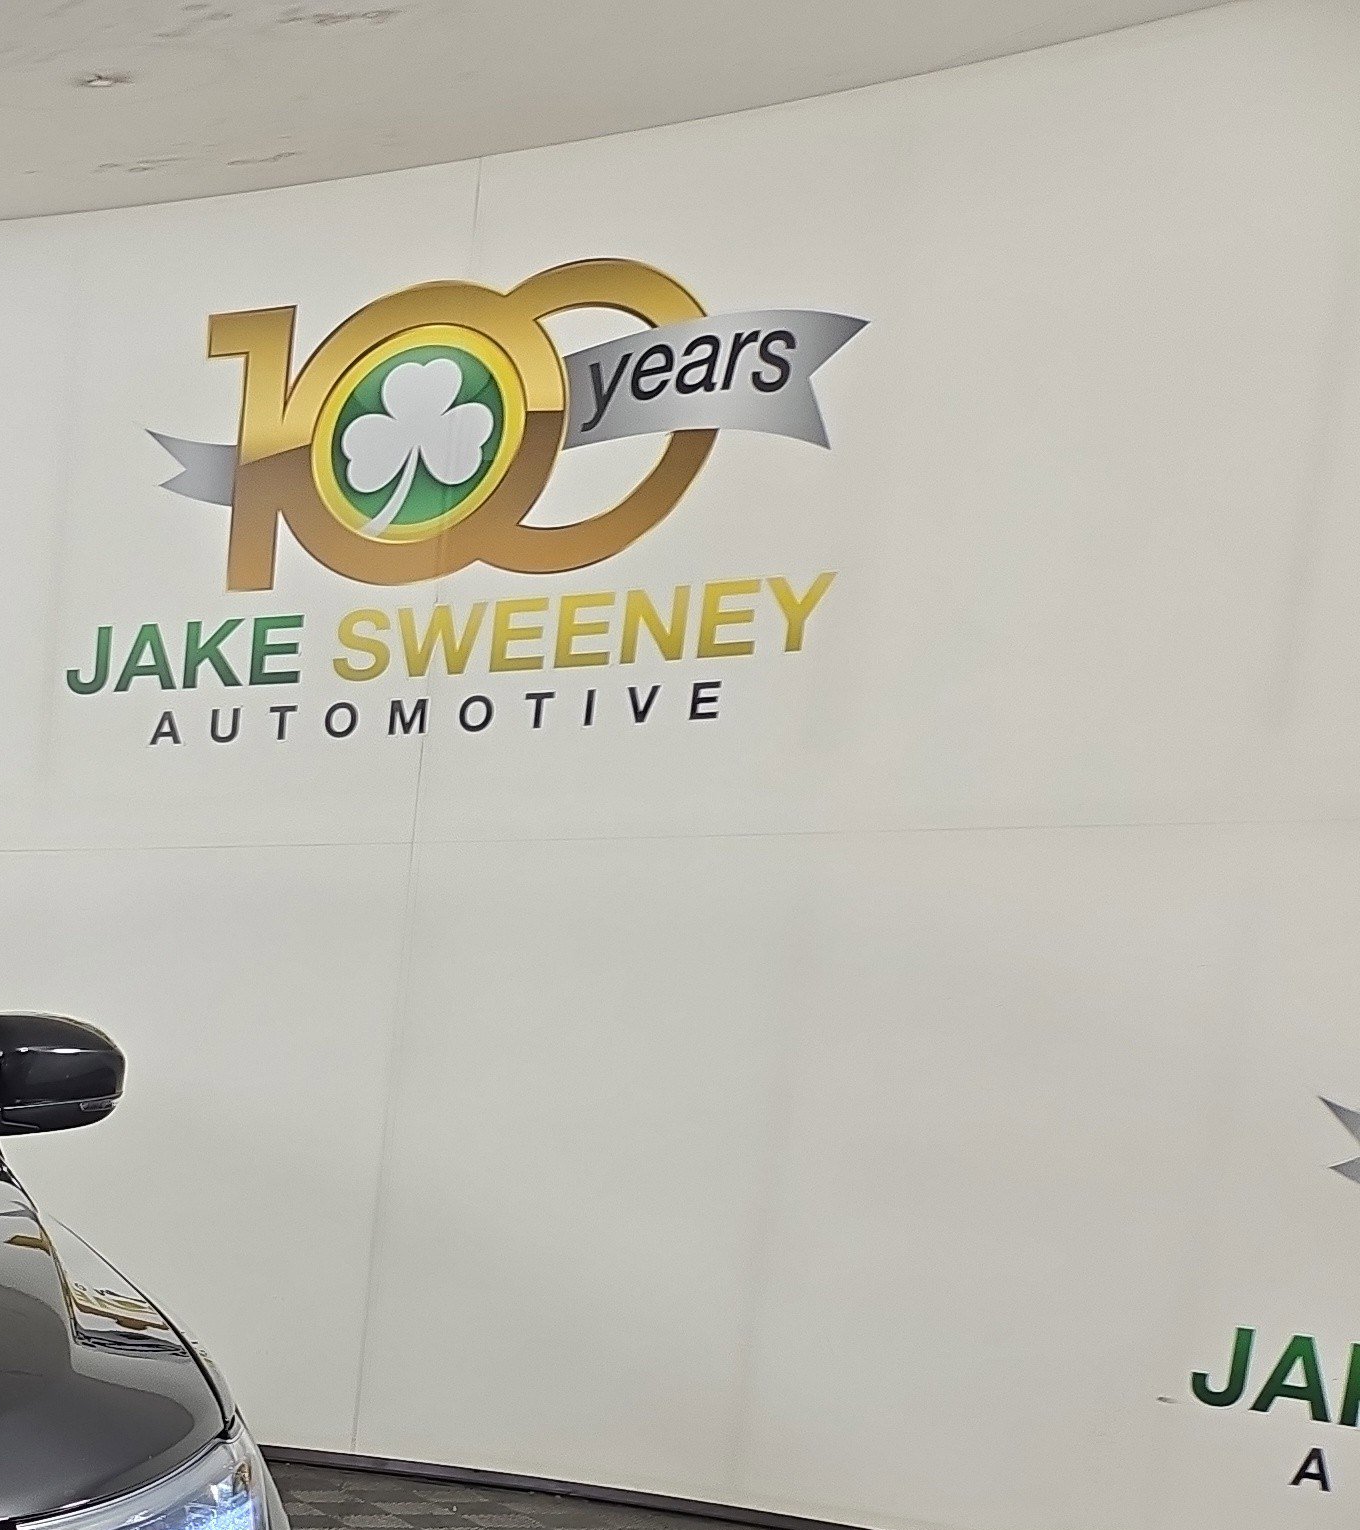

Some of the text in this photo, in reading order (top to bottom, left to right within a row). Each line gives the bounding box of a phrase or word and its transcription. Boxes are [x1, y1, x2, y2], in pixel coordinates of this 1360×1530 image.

[208, 258, 796, 591] 100 years
[66, 572, 838, 696] JAKE SWEENEY
[149, 681, 722, 746] AUTOMOTIVE
[1191, 1326, 1360, 1427] JA
